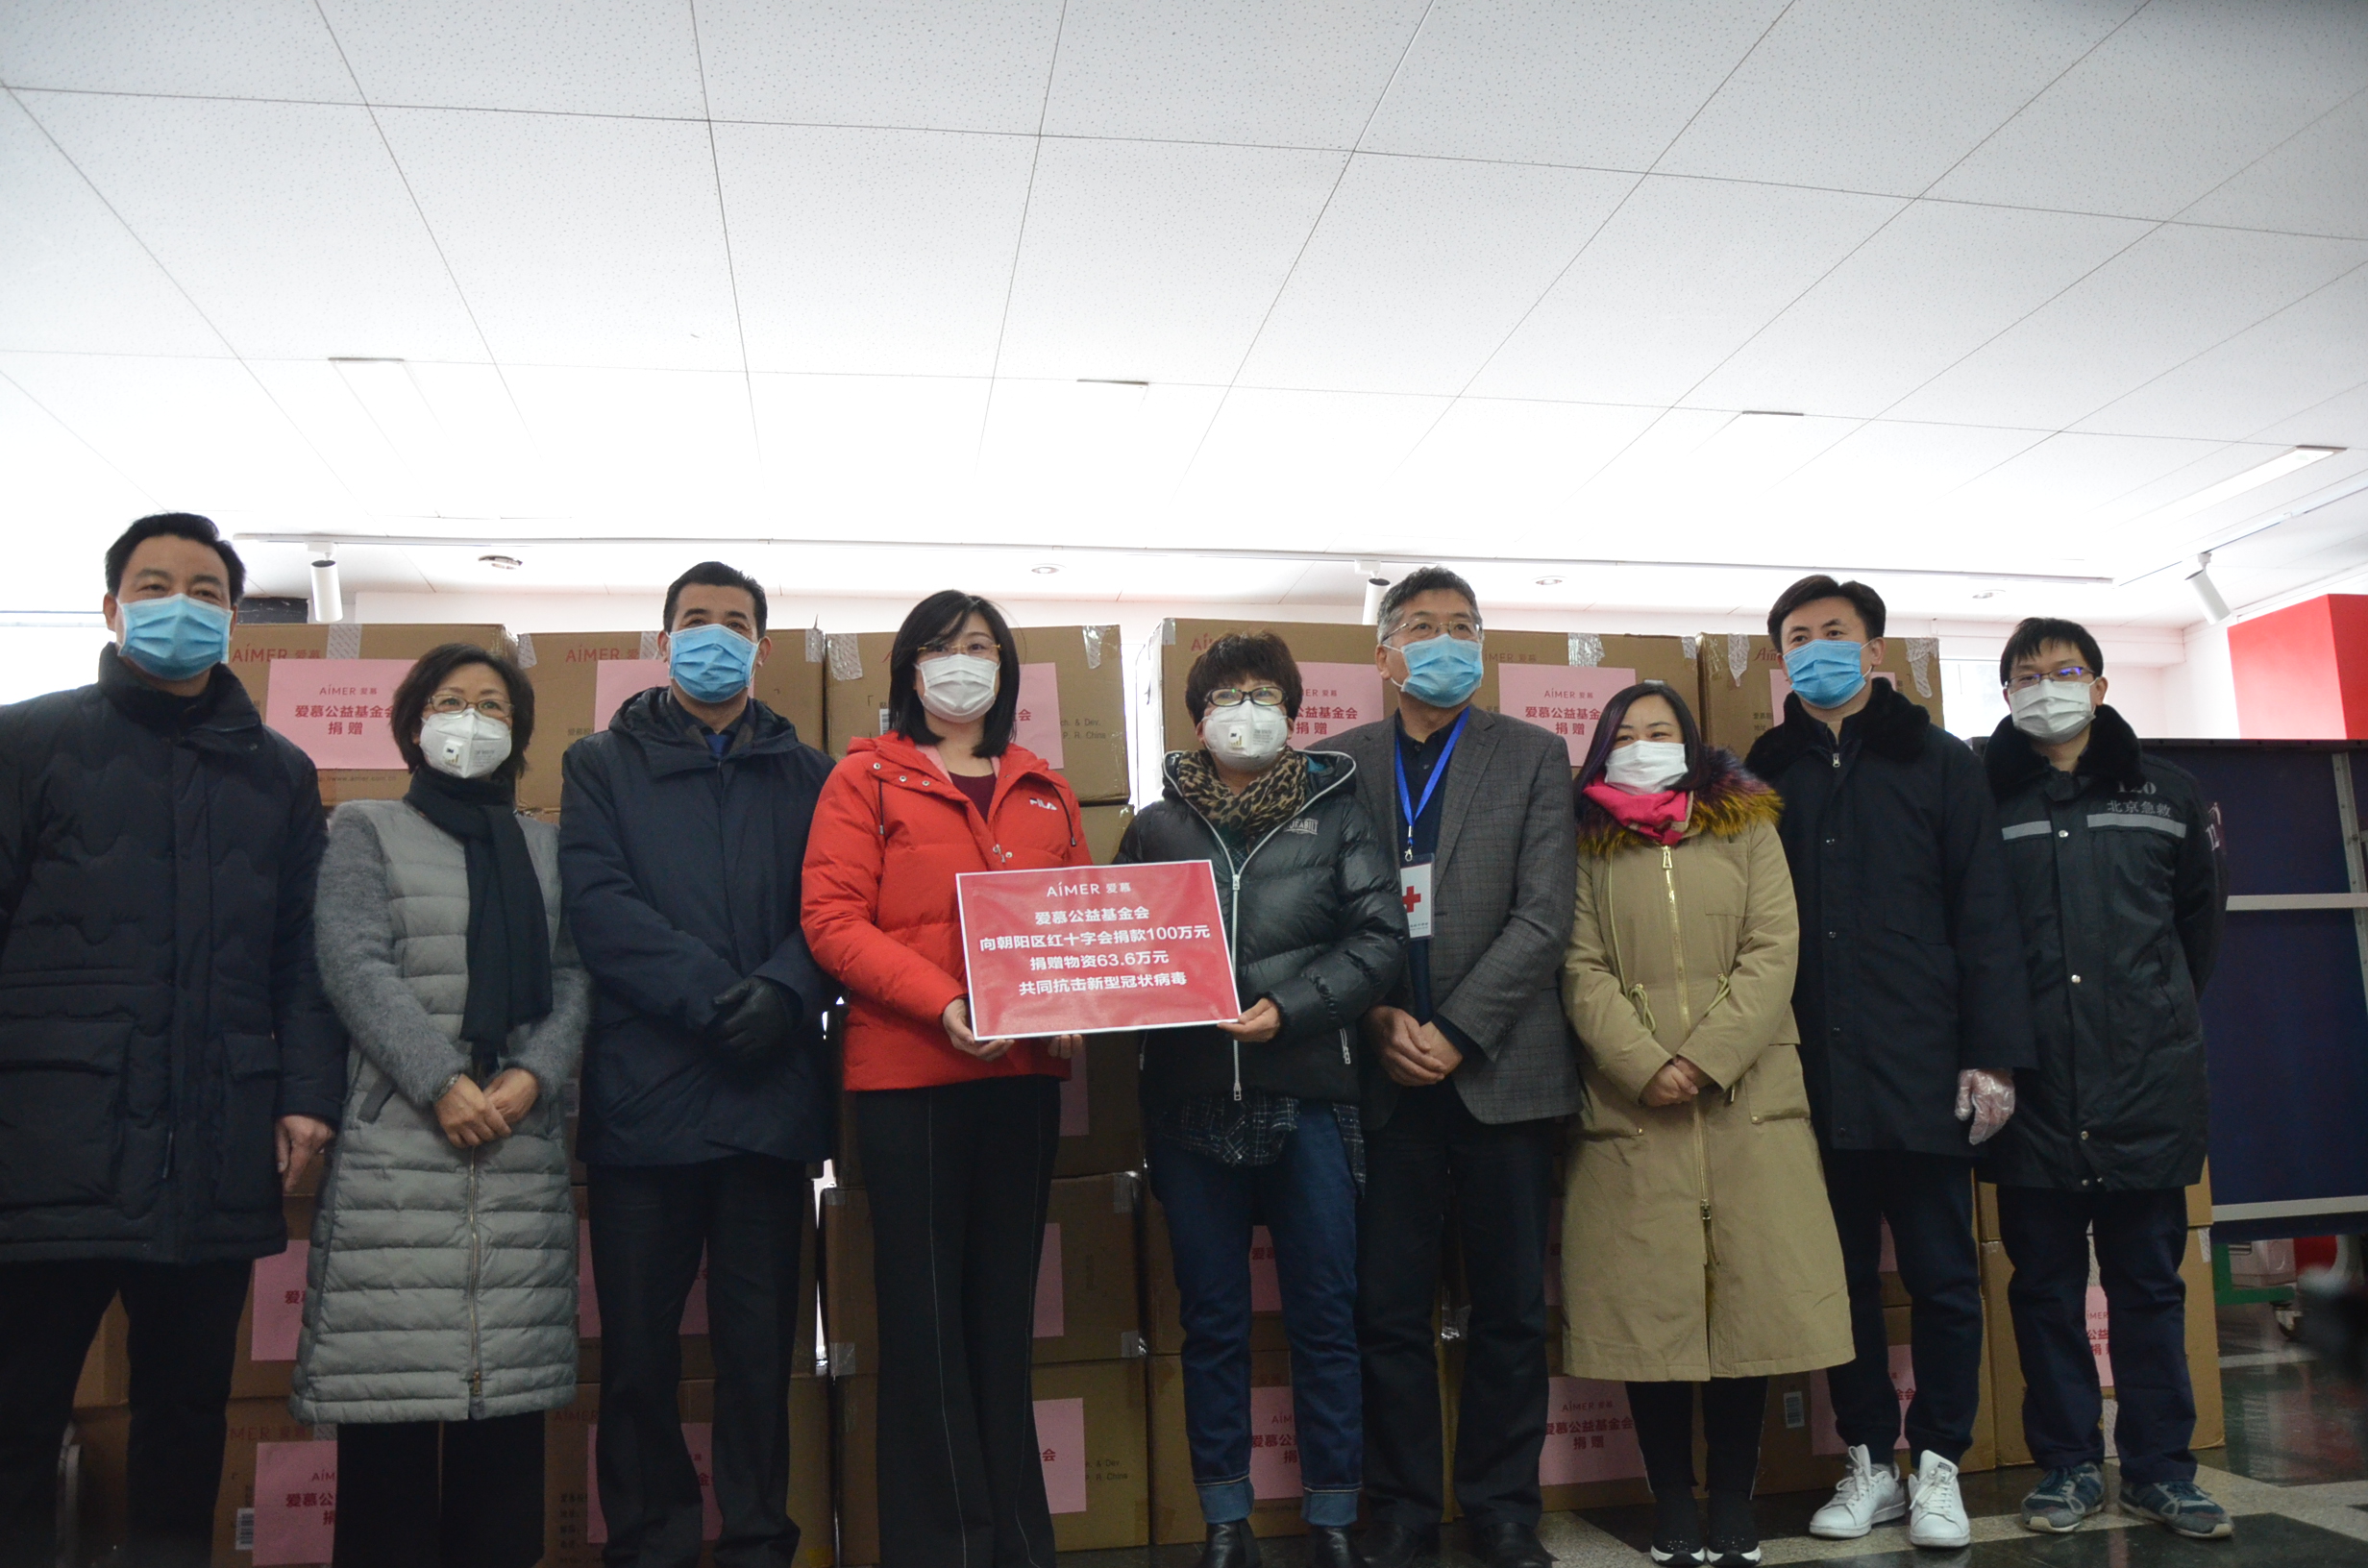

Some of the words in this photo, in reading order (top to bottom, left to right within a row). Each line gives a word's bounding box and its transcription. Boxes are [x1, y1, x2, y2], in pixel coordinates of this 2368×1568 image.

[1086, 731, 1106, 740] China
[2117, 781, 2157, 795] 10
[1029, 797, 1058, 811] FILA
[2107, 799, 2171, 818] 北京急救
[1106, 882, 1132, 894] 爱慕
[1035, 905, 1149, 925] 爱慕公益基金会
[979, 924, 1211, 952] 向朝阳区红十字会捐款100万元
[1030, 949, 1170, 971] 捐赠物资63.6万元
[1019, 970, 1188, 996] 共同抗击新型冠状病毒
[1252, 1433, 1297, 1448] 爱慕公
